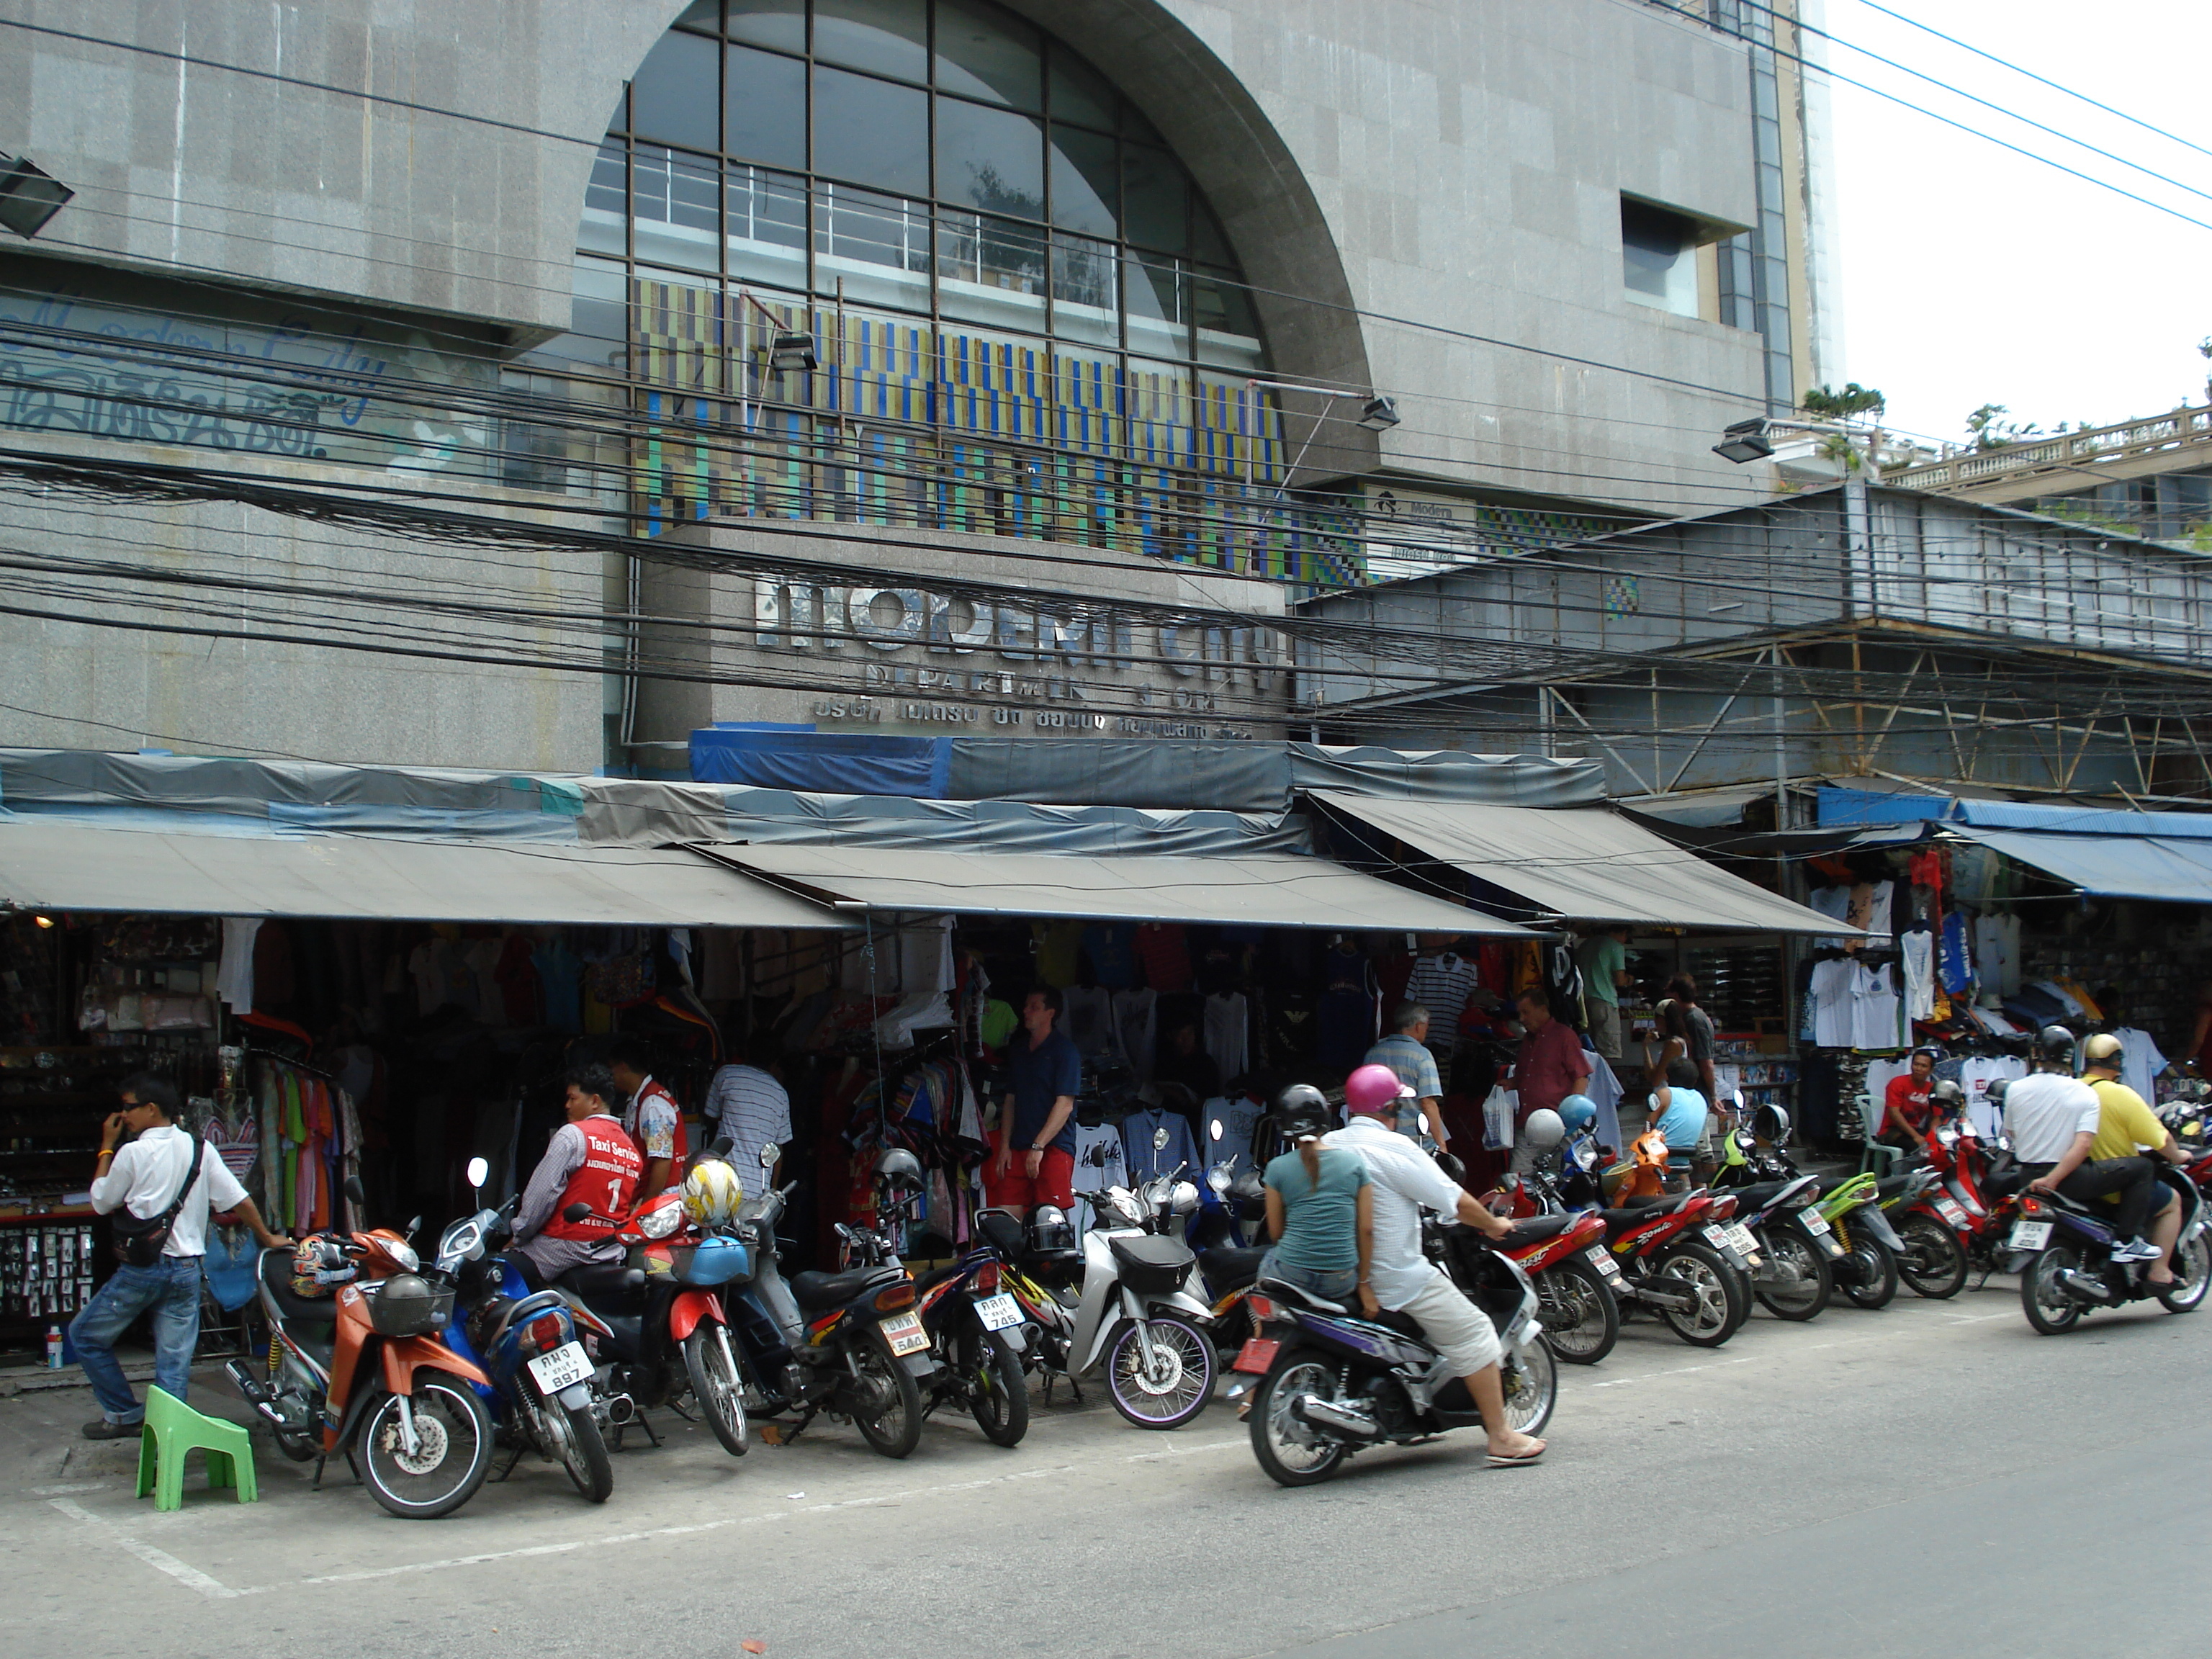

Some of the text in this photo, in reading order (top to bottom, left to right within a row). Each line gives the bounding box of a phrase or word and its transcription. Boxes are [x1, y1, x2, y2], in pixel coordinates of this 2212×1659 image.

[588, 1136, 640, 1163] Taxi Service
[607, 1178, 623, 1213] 1
[1637, 1221, 1673, 1244] Sonic
[1735, 1241, 1753, 1254] 365
[1518, 1248, 1550, 1269] Best
[991, 1314, 1017, 1328] 745
[552, 1368, 580, 1388] 897
